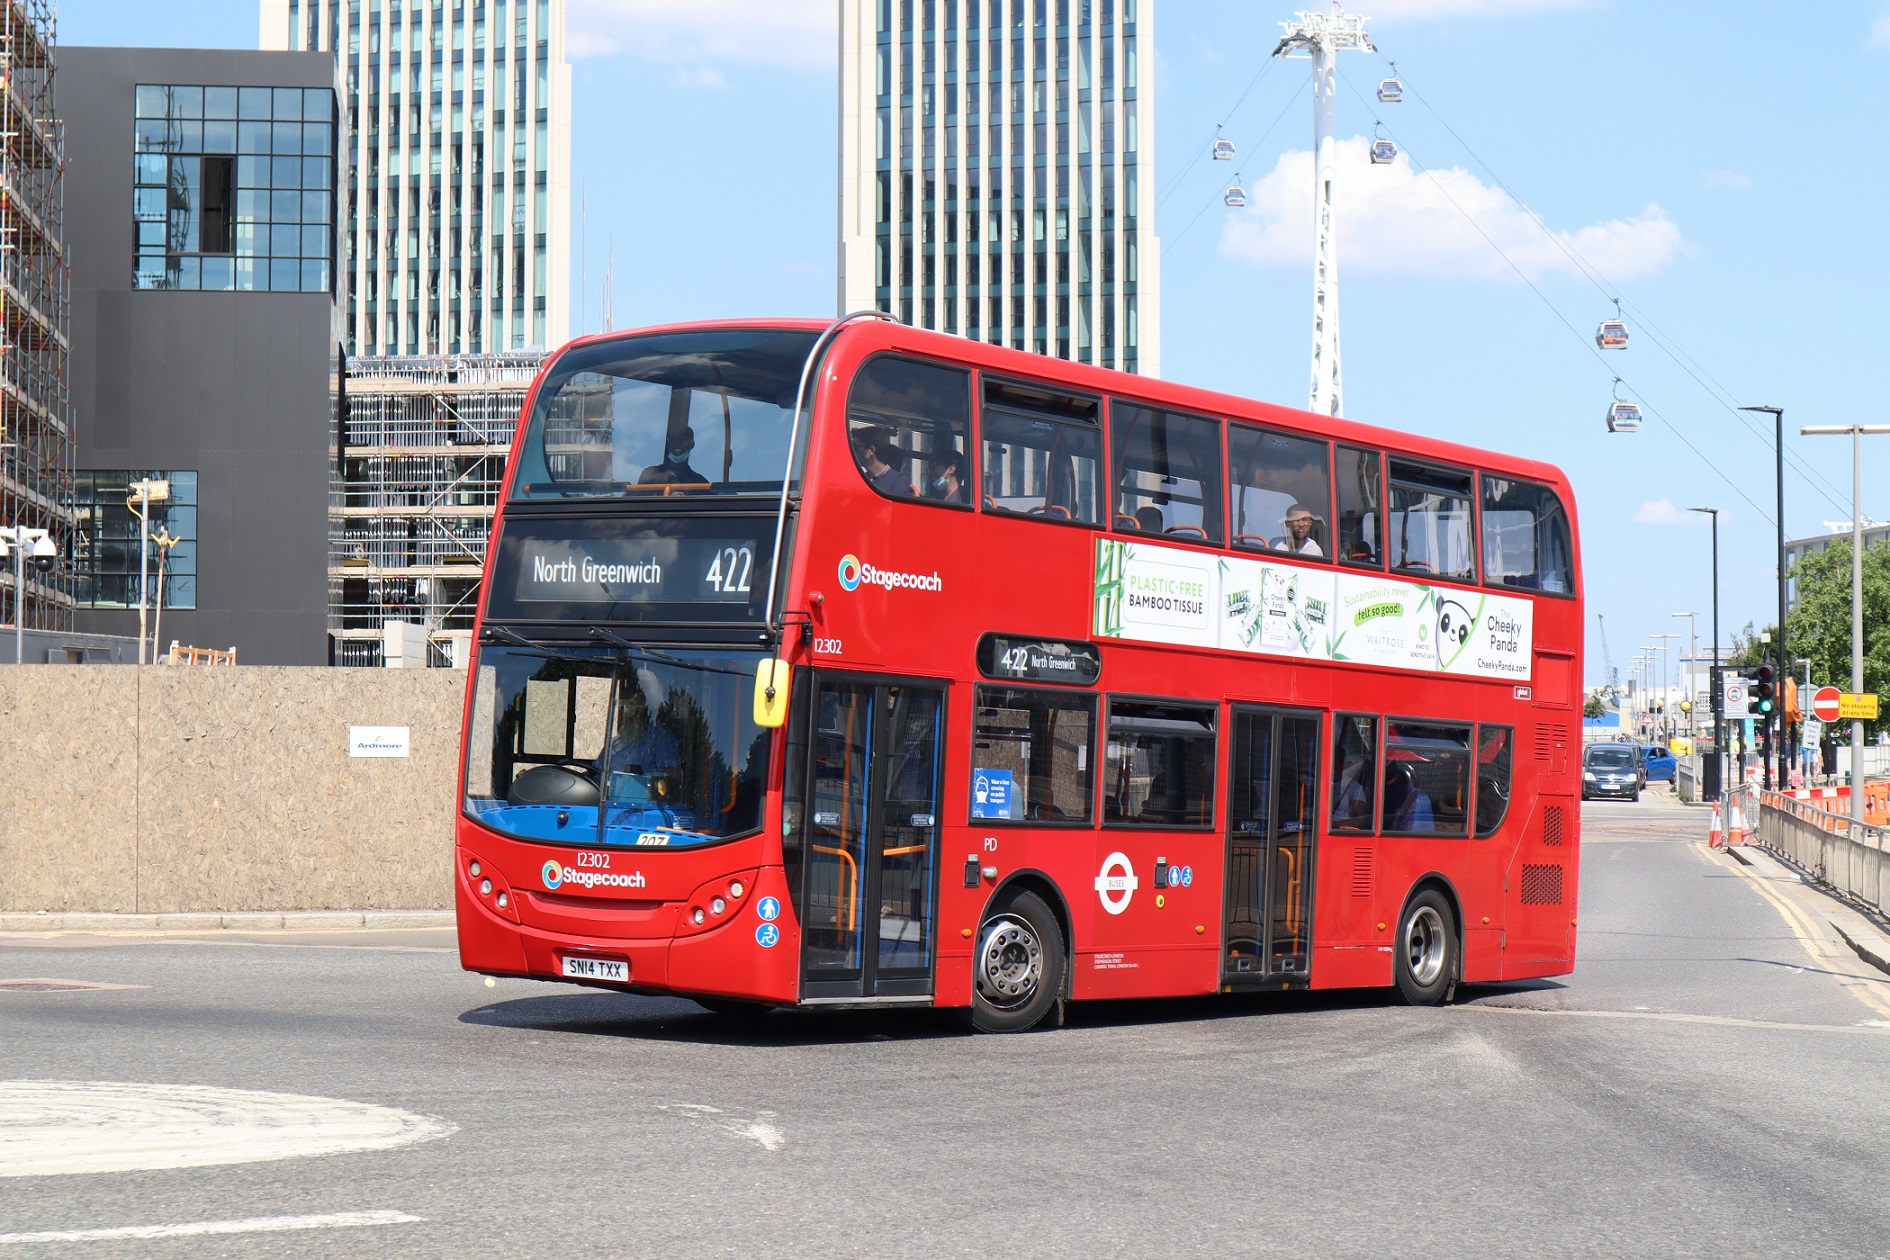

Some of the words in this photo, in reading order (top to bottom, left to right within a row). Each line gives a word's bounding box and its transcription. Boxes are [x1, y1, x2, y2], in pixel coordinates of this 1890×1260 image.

[533, 556, 576, 583] North
[581, 555, 660, 584] Greenwich
[705, 547, 750, 592] 422
[861, 564, 942, 592] Stagecoach
[1130, 575, 1204, 597] PLASTIC-FREE
[1129, 594, 1172, 611] BAMBOO
[1174, 599, 1203, 614] TISSUE
[1344, 586, 1390, 608] Sustainability
[1392, 587, 1410, 598] never
[1358, 606, 1370, 620] felt
[1372, 607, 1380, 616] so
[1381, 602, 1400, 617] good!
[1500, 608, 1510, 618] The
[1488, 616, 1522, 638] Cheeky
[814, 638, 842, 654] 12302
[1366, 635, 1404, 648] WAITROSE
[1490, 634, 1518, 653] Panda
[1001, 649, 1028, 671] 422
[1032, 654, 1047, 668] North
[1048, 654, 1076, 670] Greenwich
[1478, 658, 1528, 674] CheekyPanda.com
[984, 838, 998, 852] PD
[577, 852, 610, 869] 12302
[563, 866, 646, 888] Stagecoach
[1108, 880, 1124, 888] BUSES
[570, 959, 595, 976] SN14
[598, 961, 622, 978] TXX
